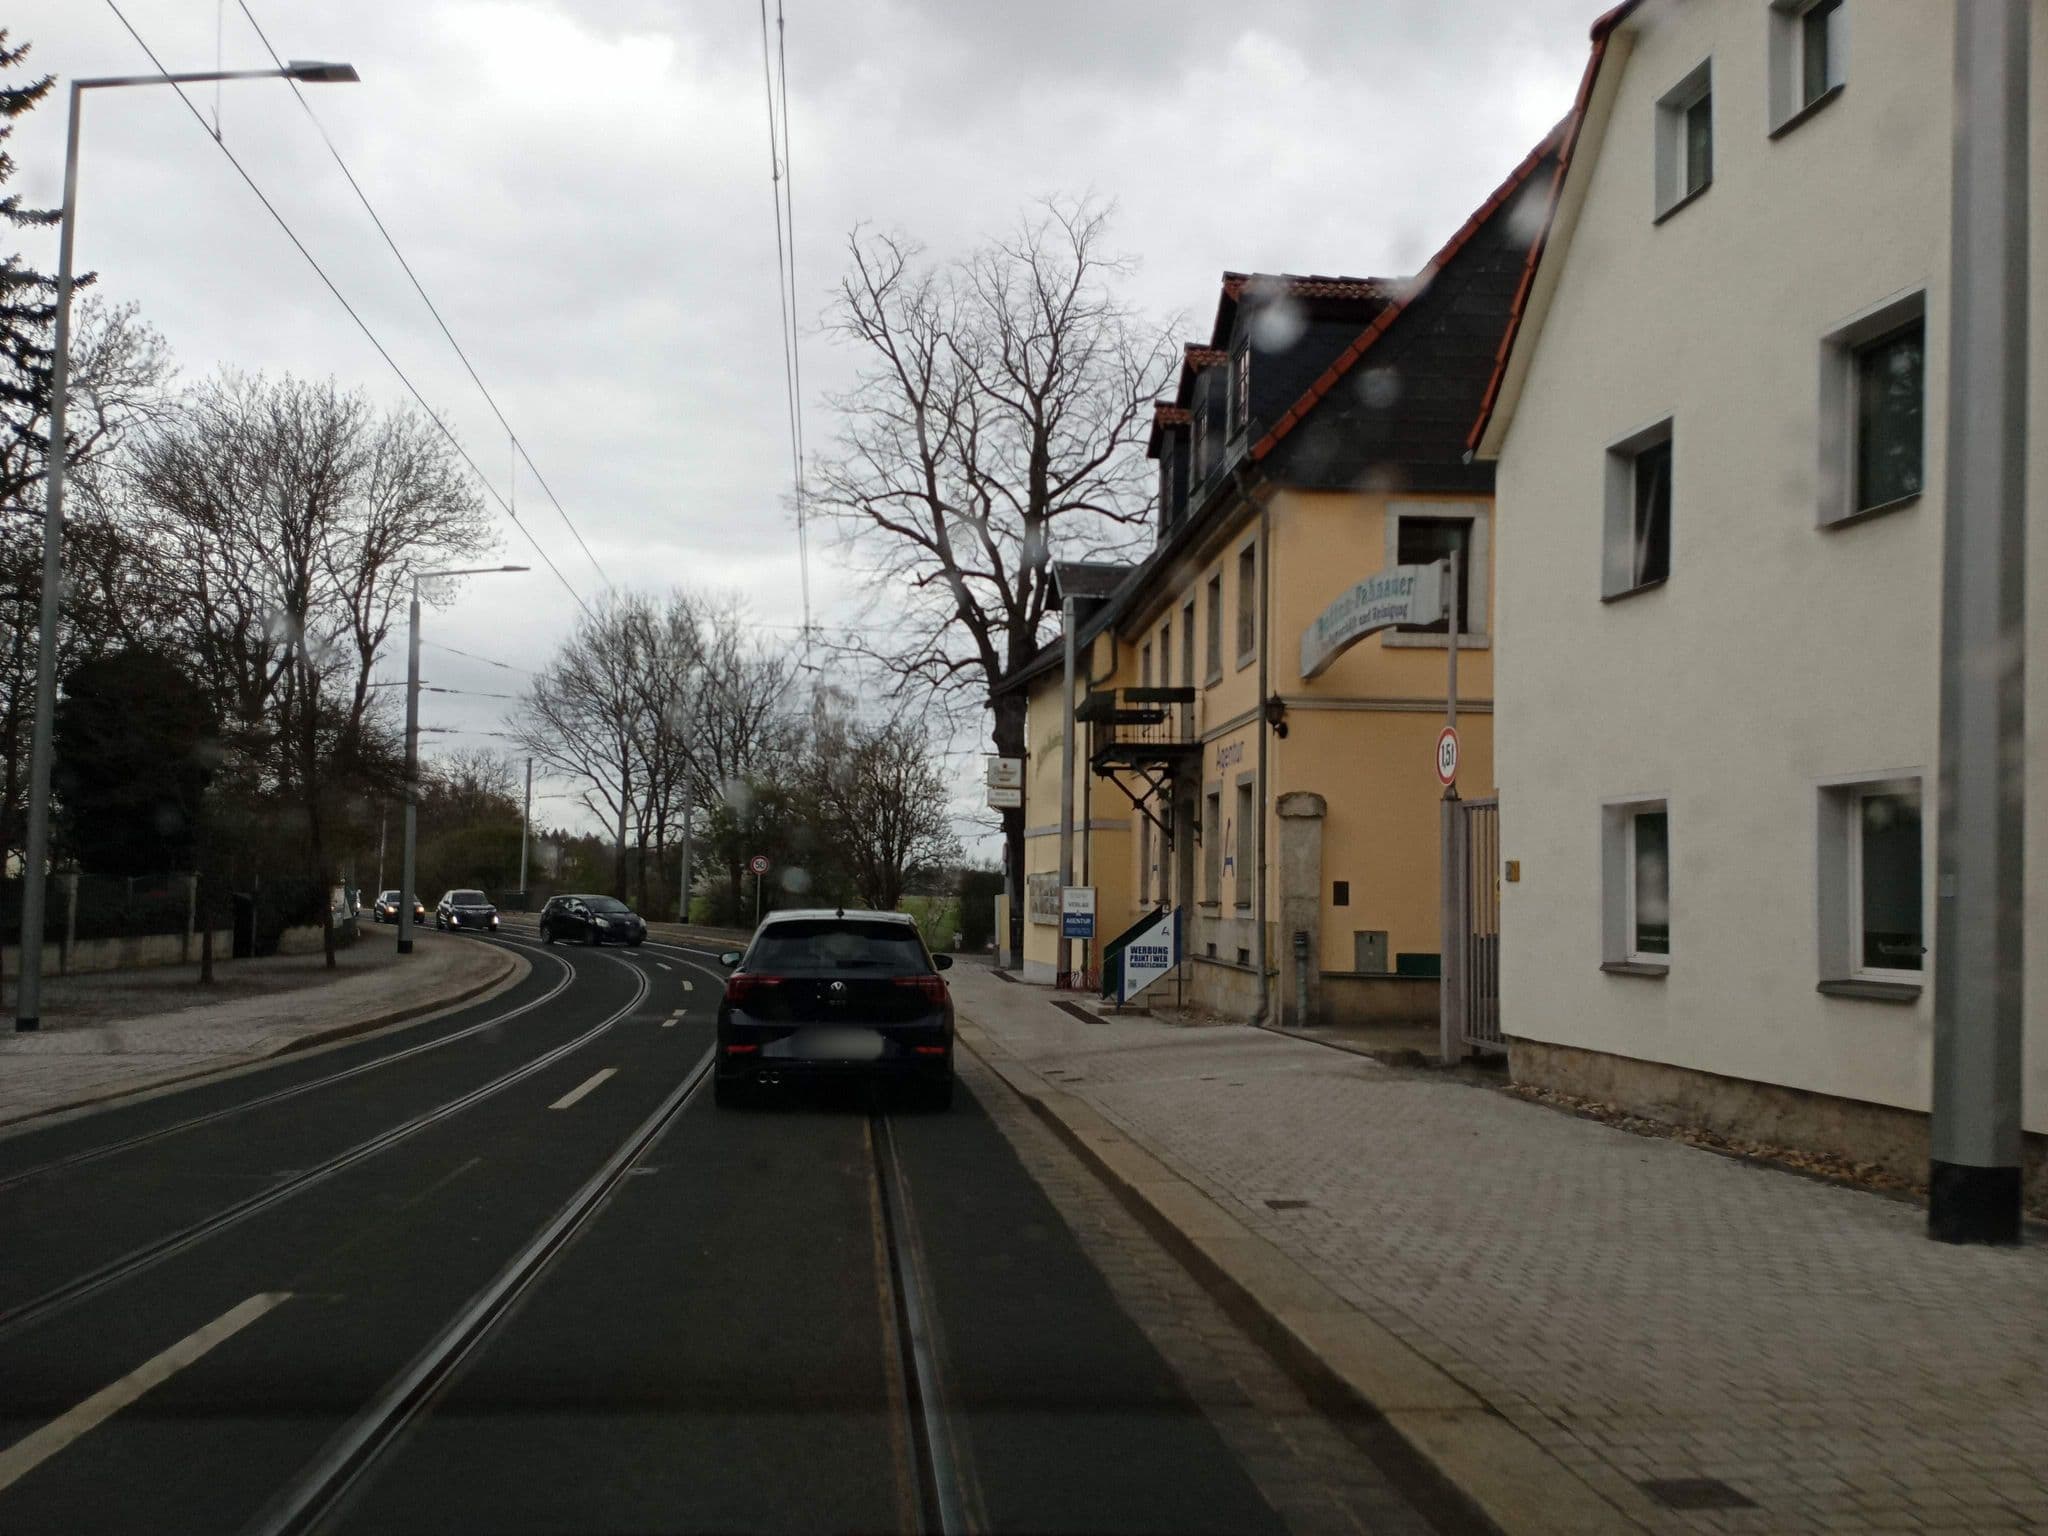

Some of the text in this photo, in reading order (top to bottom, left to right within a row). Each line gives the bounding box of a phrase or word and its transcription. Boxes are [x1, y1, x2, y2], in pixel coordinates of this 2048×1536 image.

[1130, 945, 1168, 955] WERBUNG
[1130, 954, 1168, 962] PRINT WEB
